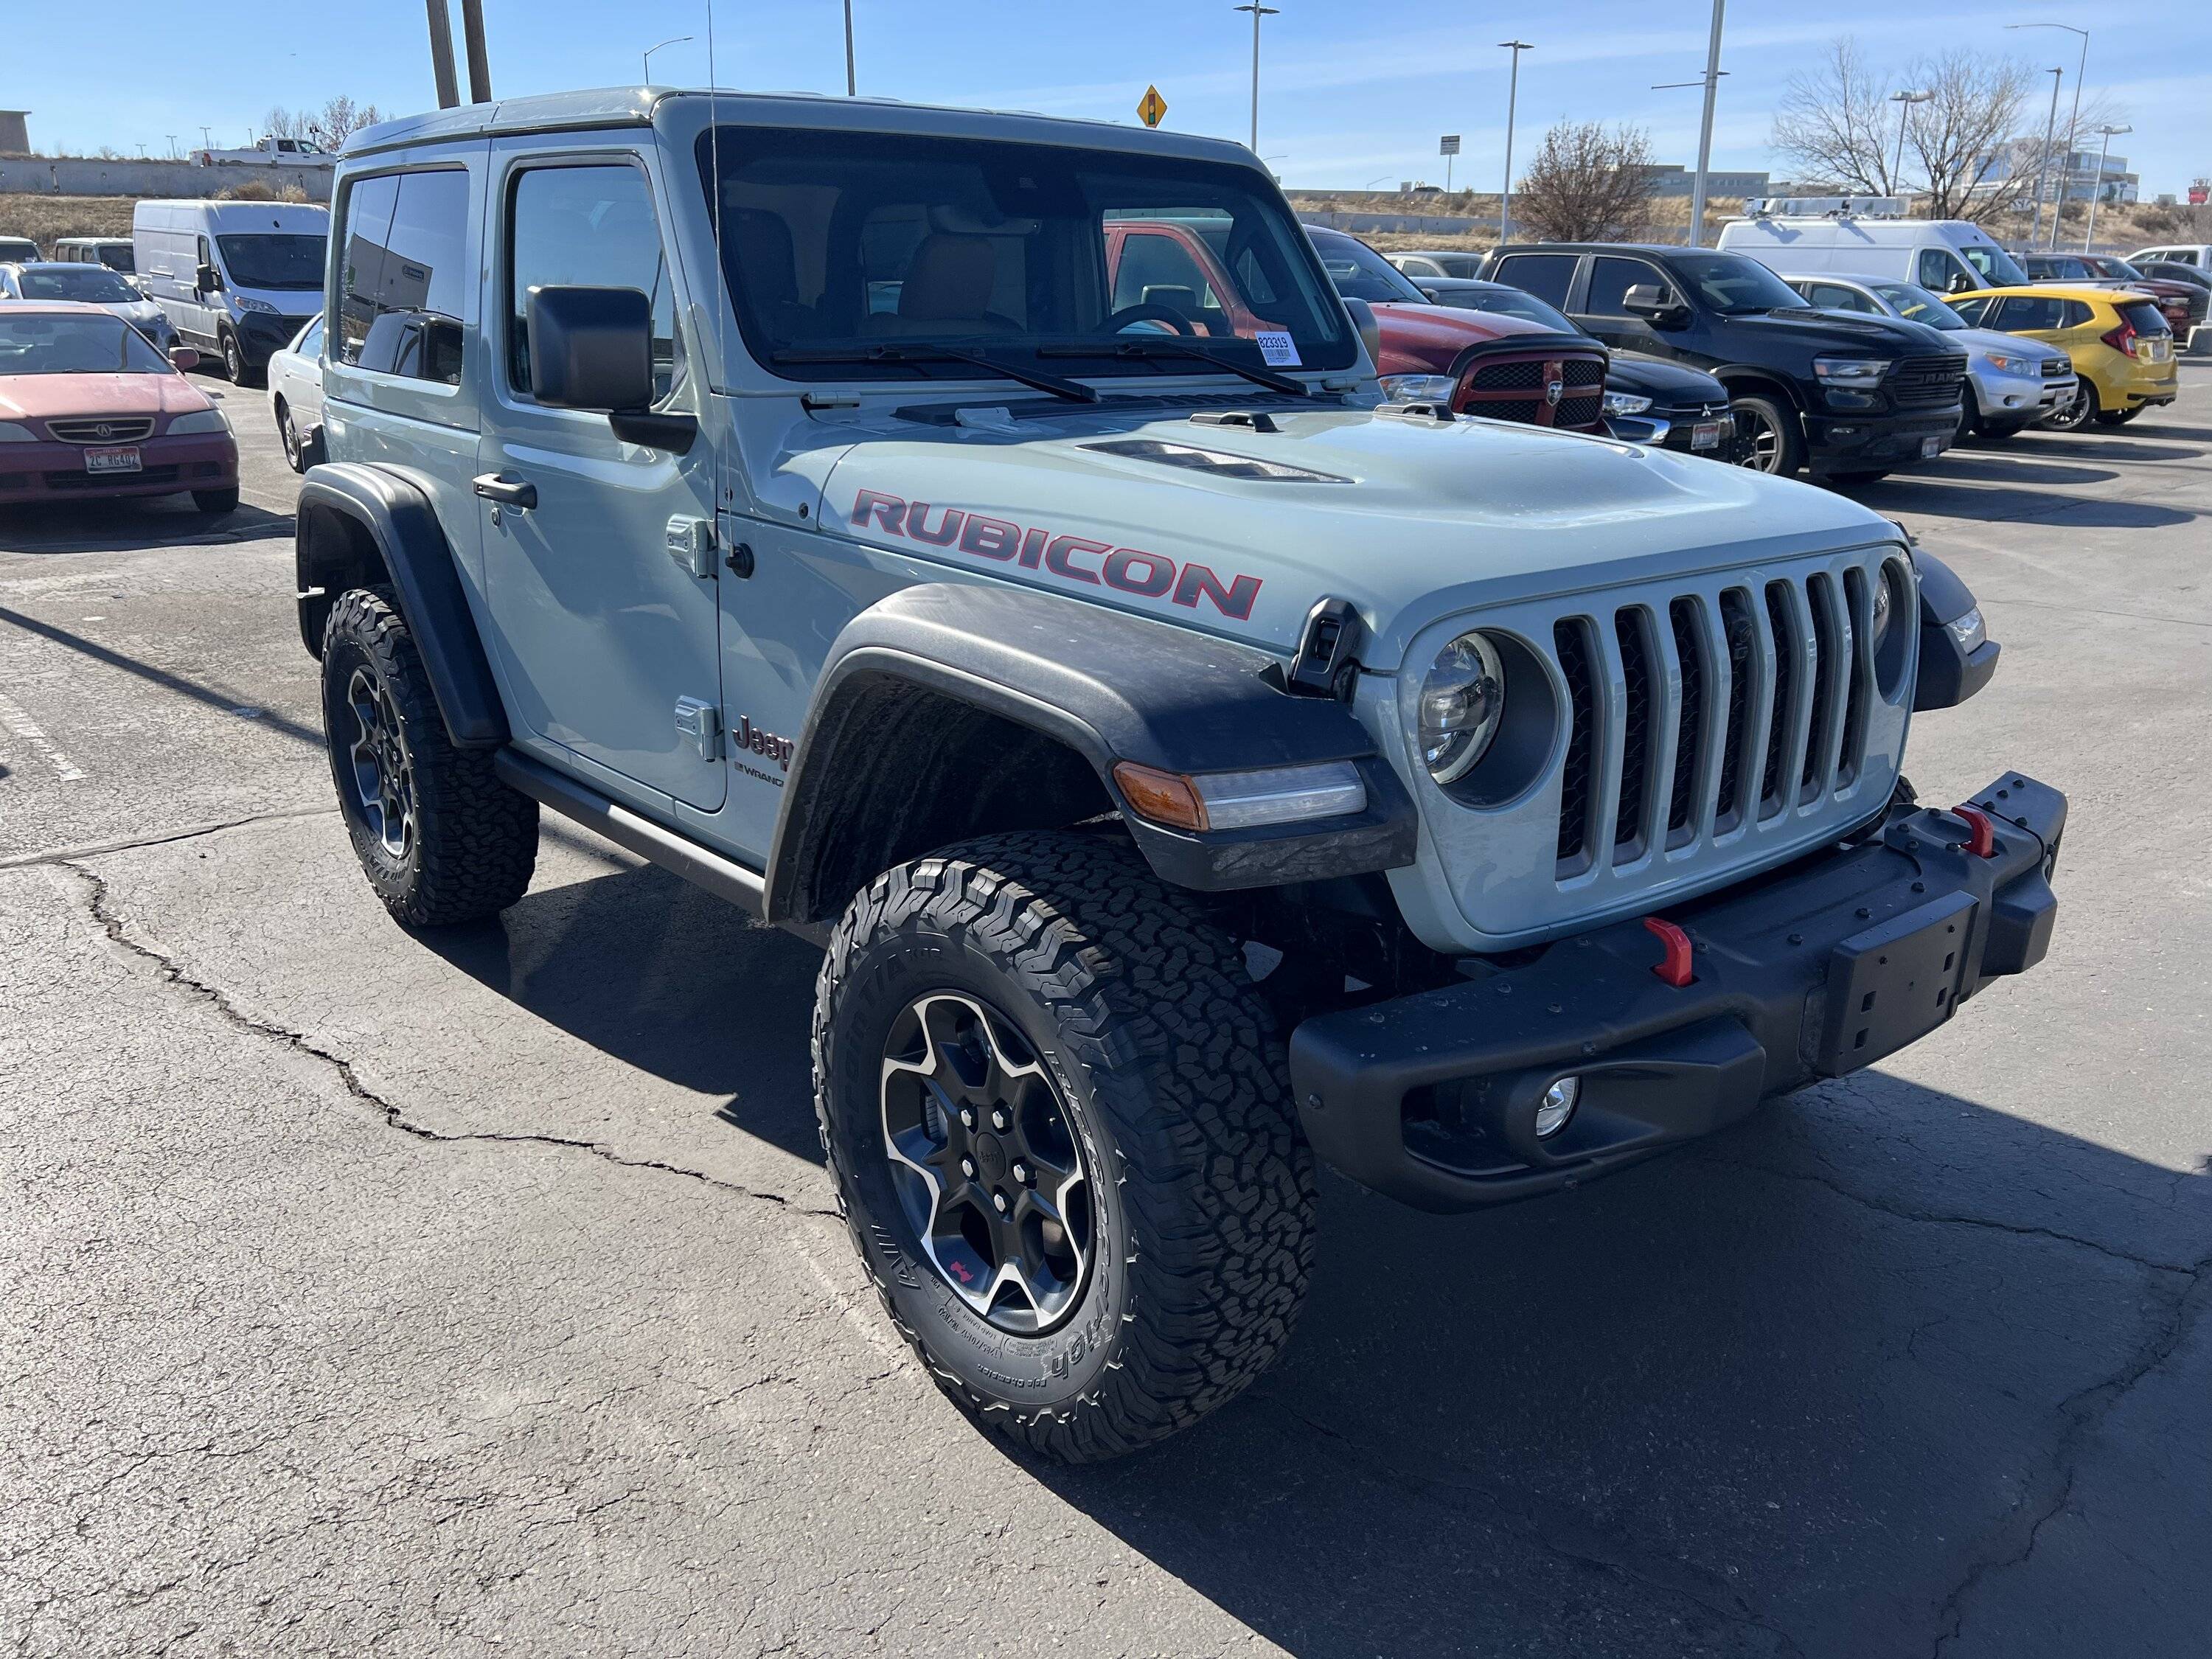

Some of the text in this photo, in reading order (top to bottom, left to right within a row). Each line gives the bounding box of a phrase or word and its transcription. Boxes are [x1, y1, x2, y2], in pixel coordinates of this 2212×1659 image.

[1258, 337, 1288, 348] 823319
[89, 456, 102, 466] 2C
[851, 488, 1264, 622] RUBICON
[732, 714, 794, 773] Jeep
